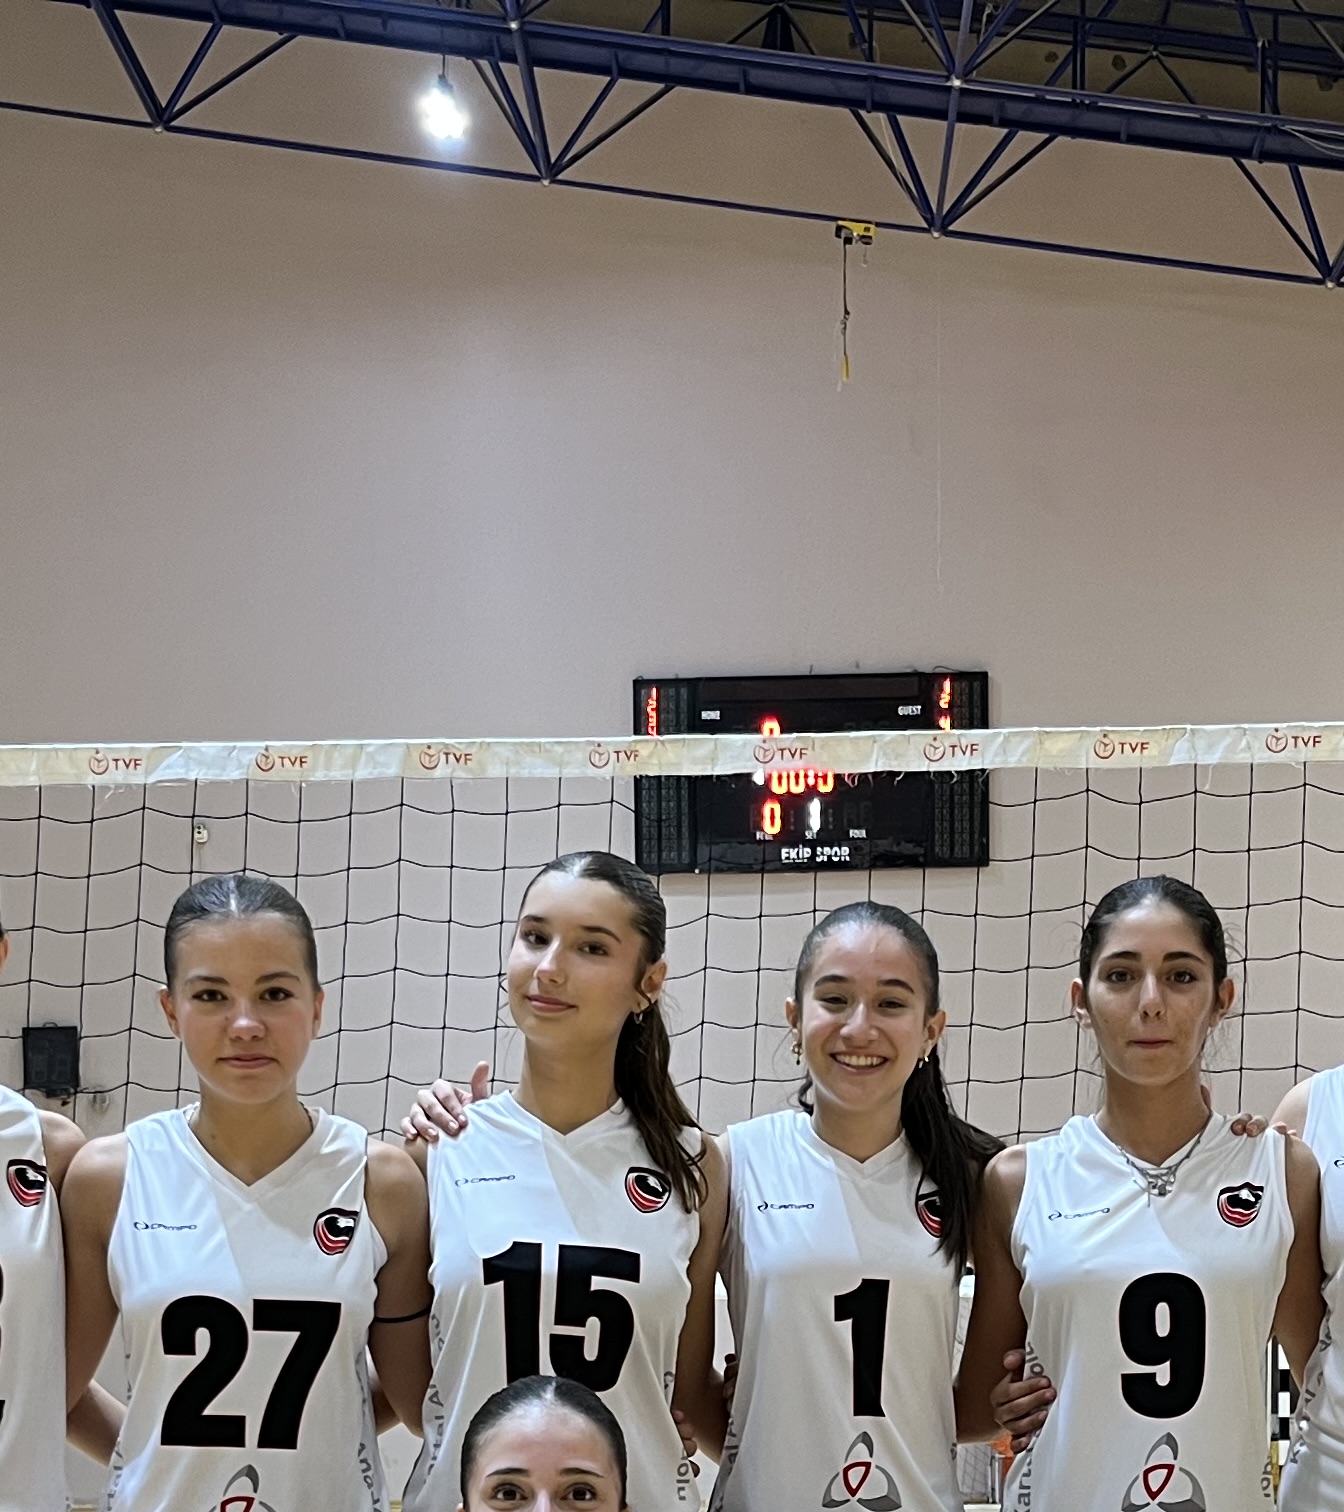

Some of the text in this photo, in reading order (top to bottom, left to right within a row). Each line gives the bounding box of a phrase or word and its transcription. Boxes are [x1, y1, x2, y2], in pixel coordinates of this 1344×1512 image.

[1118, 741, 1149, 754] TVF
[1291, 735, 1322, 748] TVF
[613, 750, 640, 763] TVF
[777, 747, 808, 760] TVF
[948, 743, 980, 757] TVF
[112, 758, 142, 770] TVF
[278, 755, 308, 767] TVF
[443, 752, 472, 765] TVF
[481, 1240, 641, 1393] 15
[832, 1277, 891, 1418] 1
[1118, 1270, 1207, 1419] 9
[159, 1294, 342, 1450] 27
